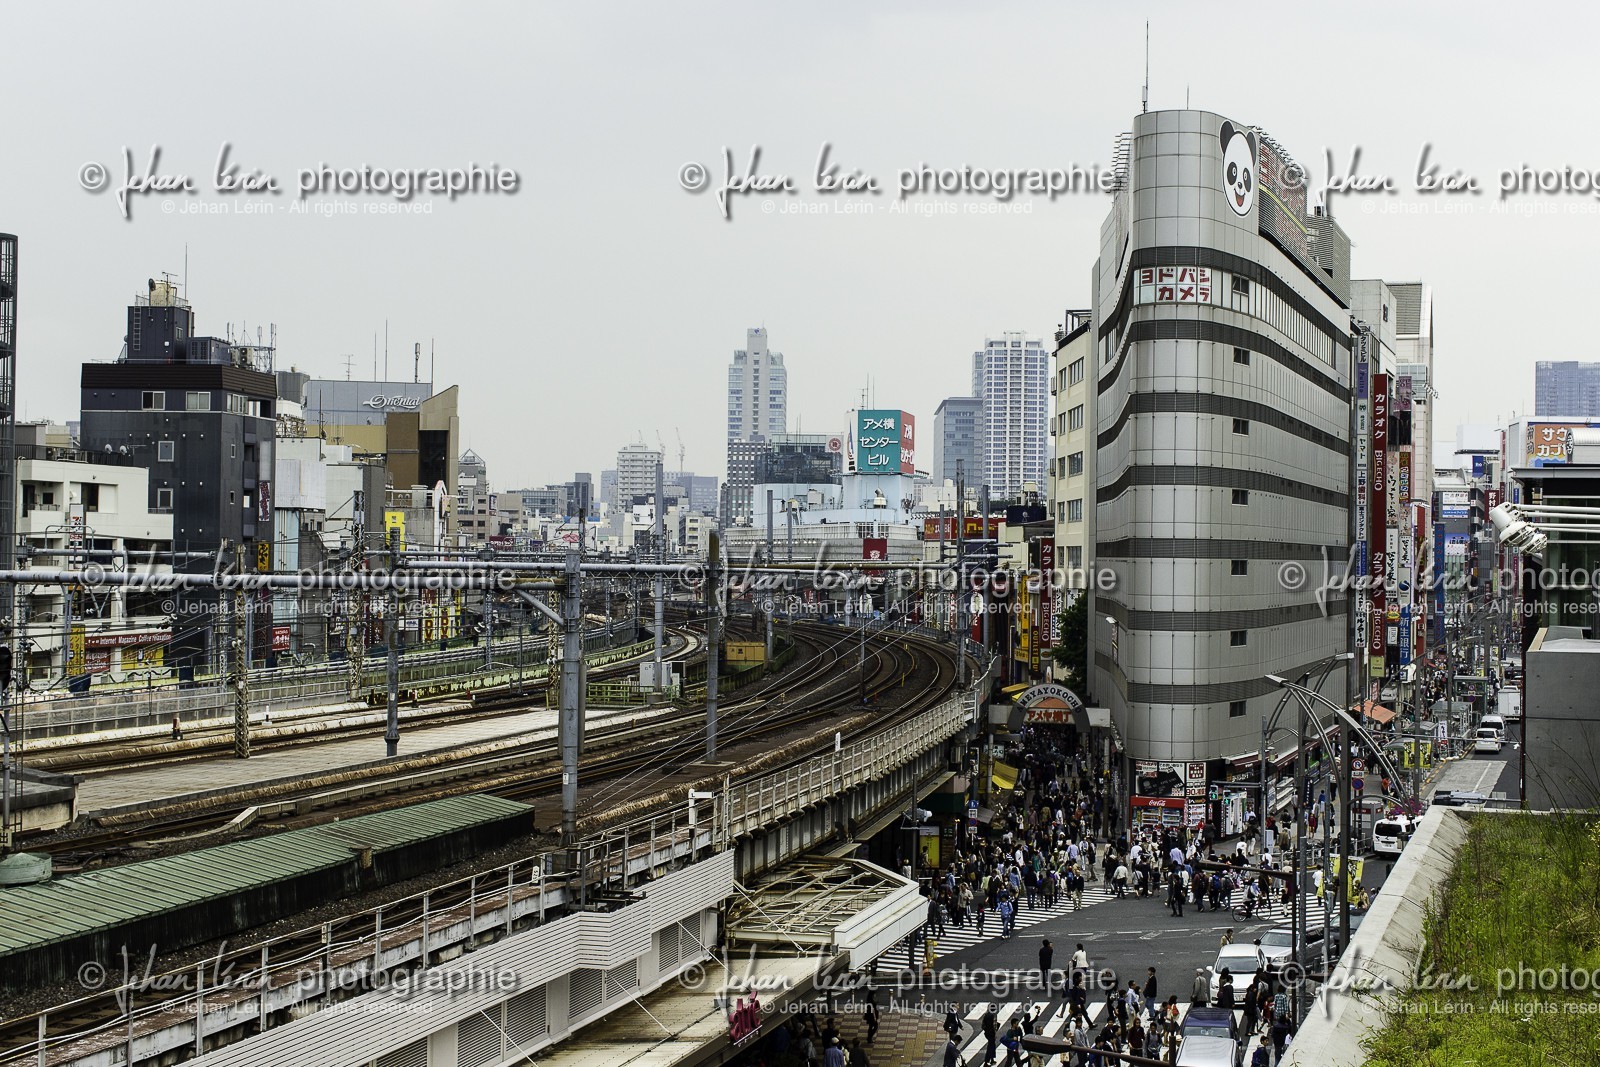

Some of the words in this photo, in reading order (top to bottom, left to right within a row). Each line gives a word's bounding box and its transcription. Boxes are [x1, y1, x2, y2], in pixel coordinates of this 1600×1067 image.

[1142, 268, 1210, 284] ヨドバシ
[1159, 287, 1210, 301] カメラ
[363, 394, 421, 409] Oriental
[1375, 394, 1386, 439] カラオケ
[863, 418, 895, 430] アメ横
[860, 436, 898, 448] センター
[868, 454, 889, 466] ビル
[1373, 551, 1384, 597] カラオケ
[100, 637, 117, 645] Internet
[118, 636, 137, 645] Magazine
[1399, 617, 1410, 658] 新生銀行
[1027, 710, 1073, 722] アメヤ横丁
